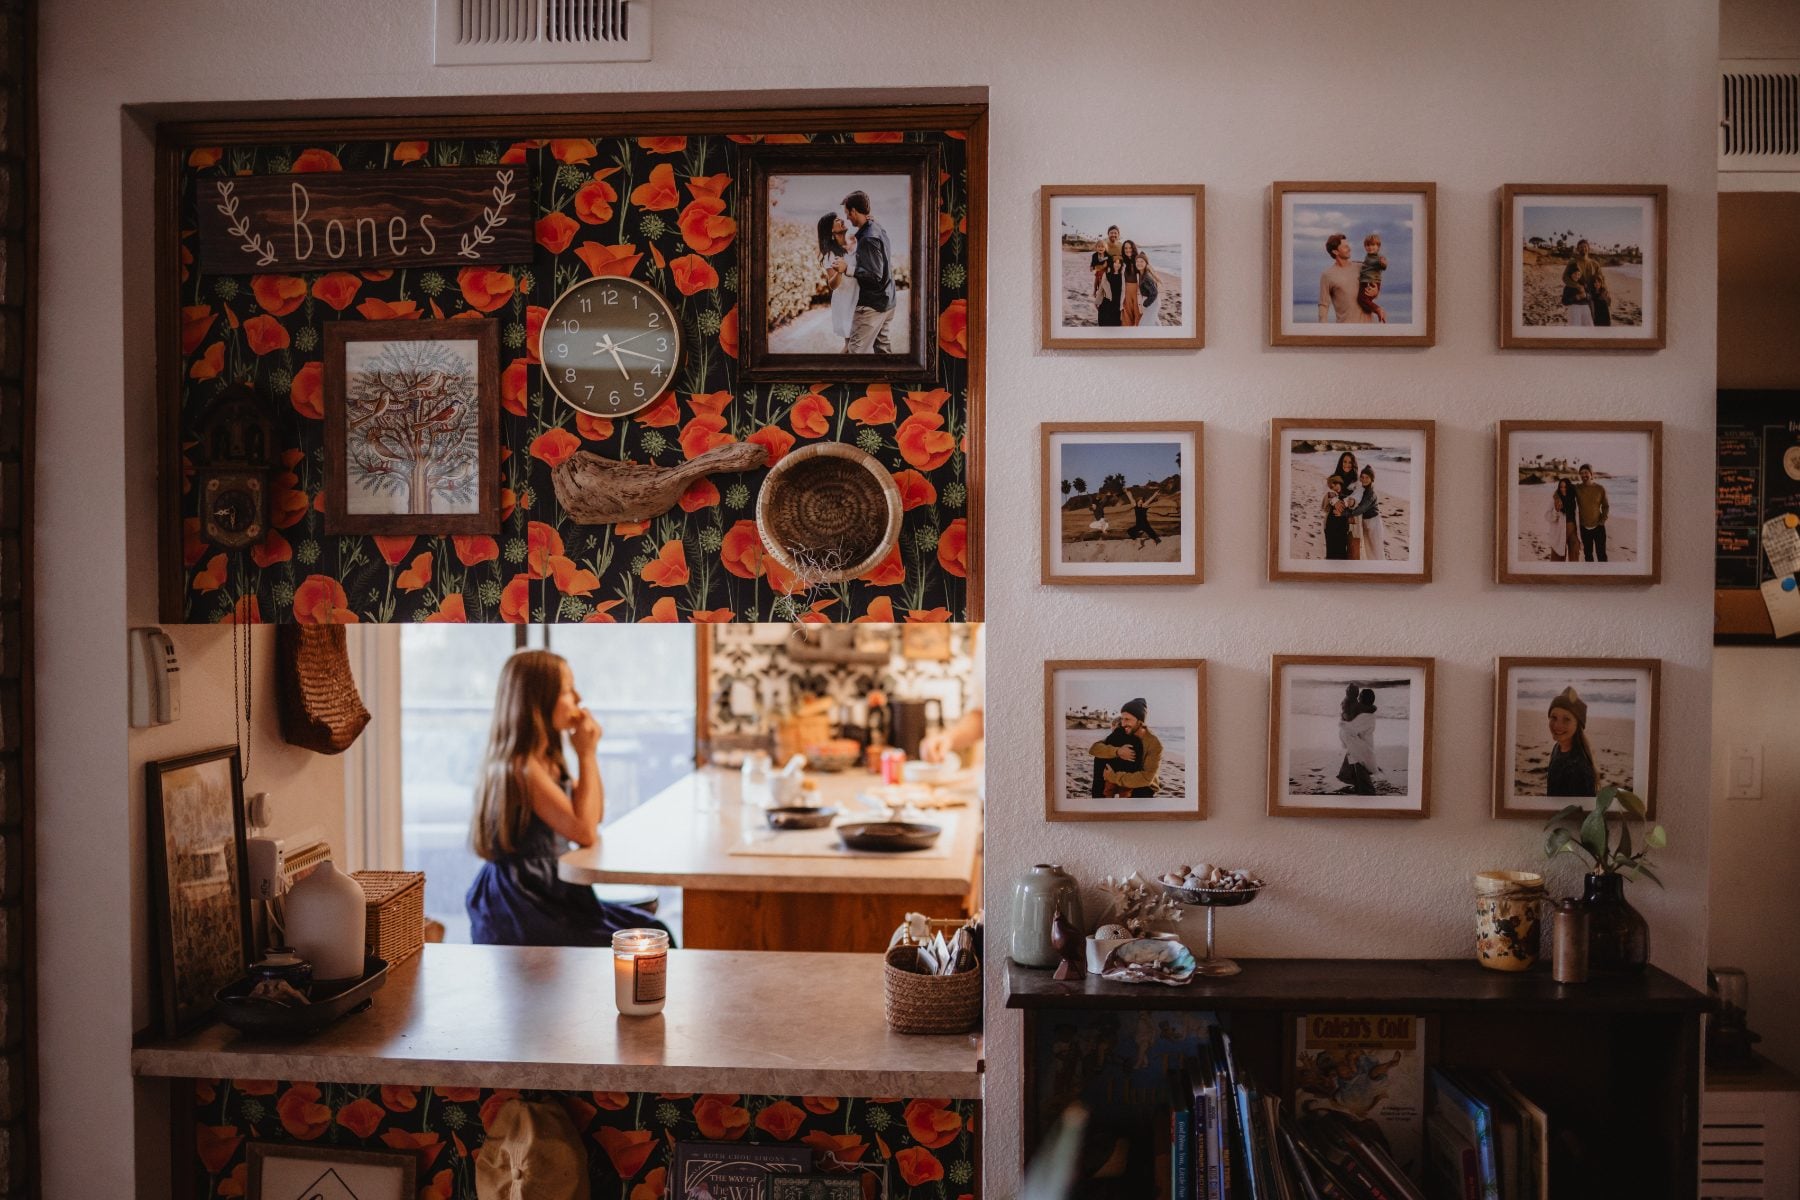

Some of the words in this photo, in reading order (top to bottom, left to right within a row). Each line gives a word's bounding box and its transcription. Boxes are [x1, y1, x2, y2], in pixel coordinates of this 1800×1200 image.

[292, 182, 436, 260] Bones
[601, 290, 619, 305] 12
[632, 295, 638, 310] 1
[580, 298, 592, 313] 11
[561, 319, 580, 334] 10
[648, 313, 660, 328] 2
[557, 343, 569, 358] 9
[656, 337, 668, 352] 3
[565, 368, 577, 383] 8
[650, 363, 662, 378] 4
[584, 385, 595, 401] 7
[633, 382, 645, 397] 5
[609, 391, 621, 406] 6
[710, 1174, 728, 1182] THE
[729, 1175, 745, 1183] WAY
[746, 1176, 759, 1184] OF
